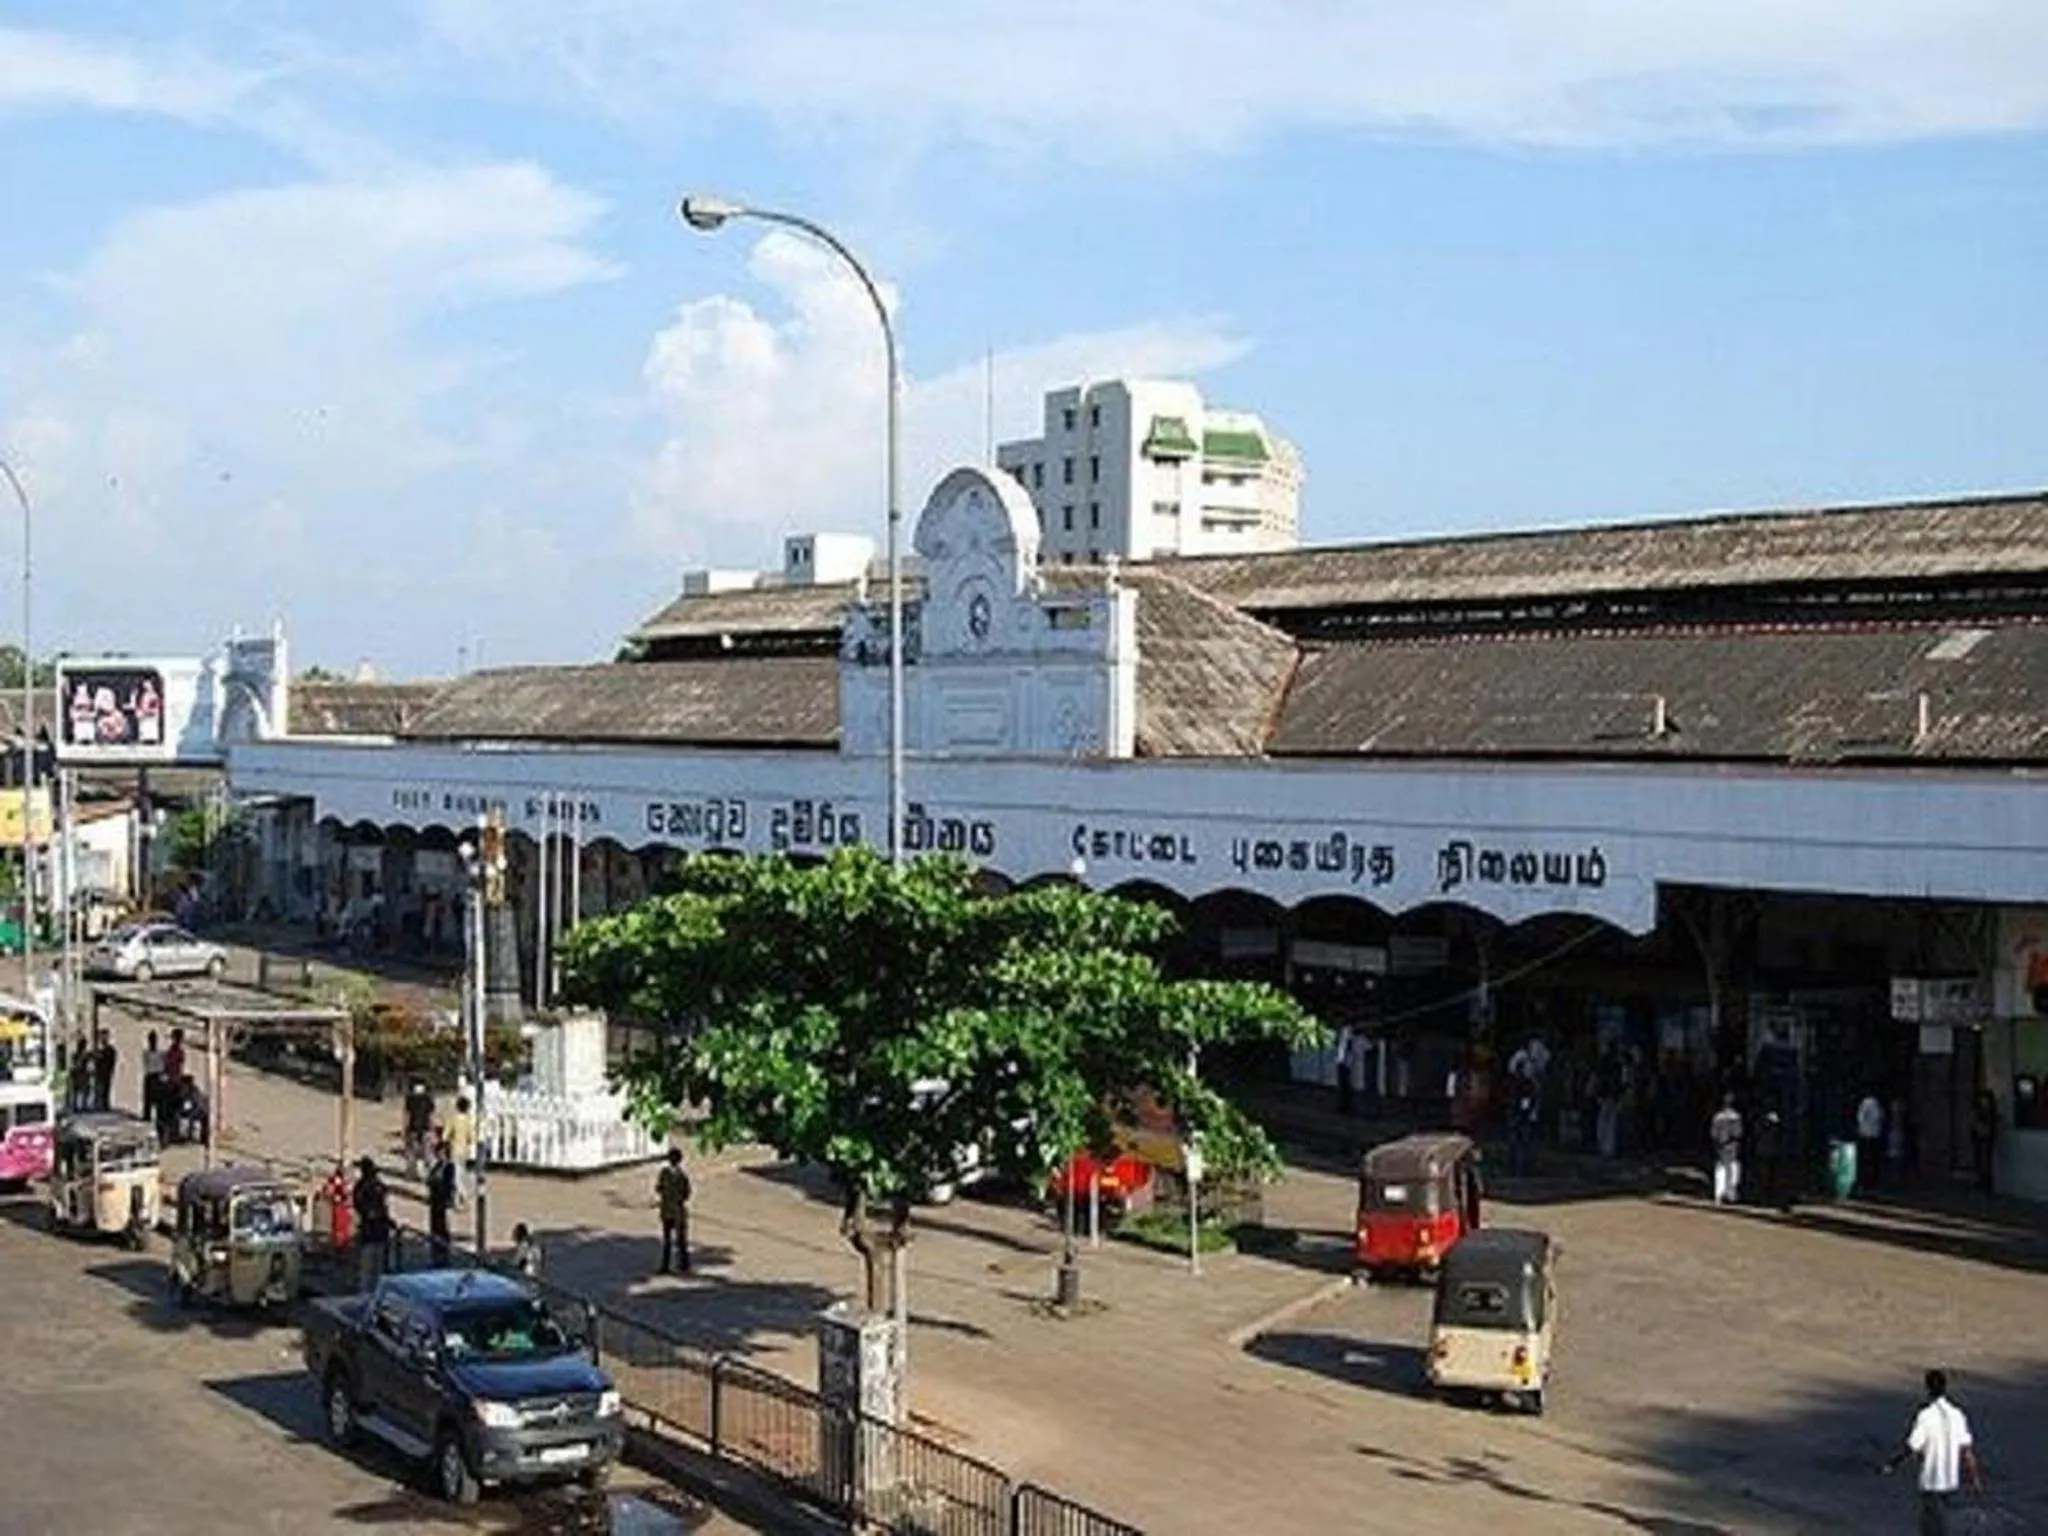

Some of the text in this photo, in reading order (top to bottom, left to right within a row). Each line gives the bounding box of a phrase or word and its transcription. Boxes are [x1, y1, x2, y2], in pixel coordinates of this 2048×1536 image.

[1072, 824, 1607, 892] கோட்டை புகையிரத நிலையம்
